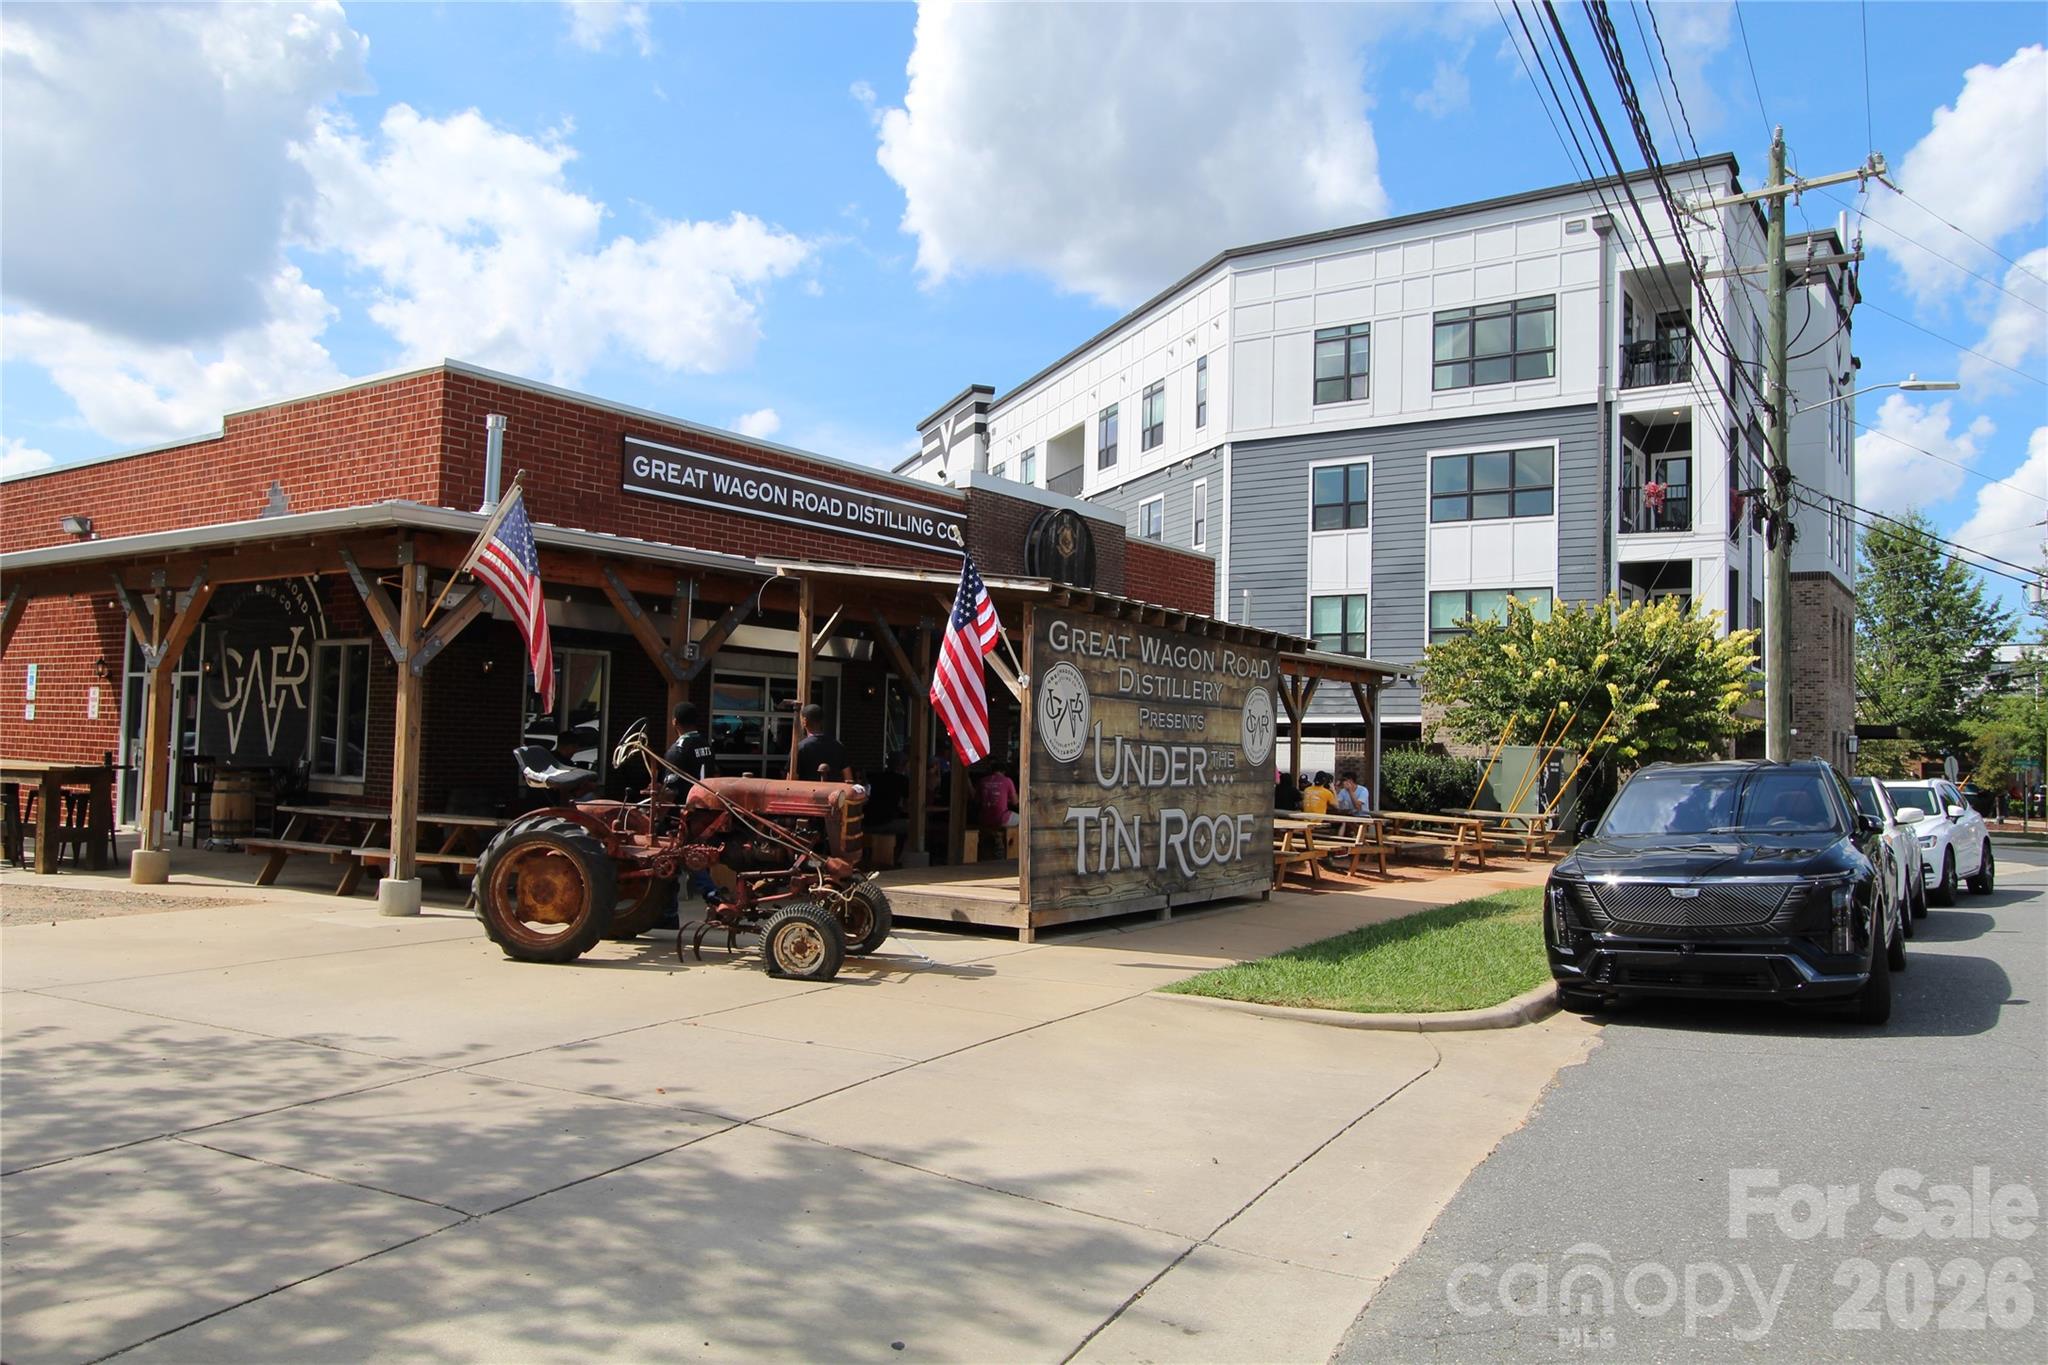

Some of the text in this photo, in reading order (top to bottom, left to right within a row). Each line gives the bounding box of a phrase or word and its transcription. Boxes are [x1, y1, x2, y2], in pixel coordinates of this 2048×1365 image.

[632, 455, 708, 489] GREAT
[712, 473, 788, 506] WAGON
[792, 490, 843, 517] ROAD
[846, 502, 934, 536] DISTILLING
[1049, 620, 1271, 679] GREAT WAGON ROAD
[1119, 667, 1224, 702] DISTILLERY
[1139, 707, 1206, 731] PRESENTS
[1094, 720, 1236, 789] UNDER THE
[1064, 805, 1255, 879] TIN ROOF
